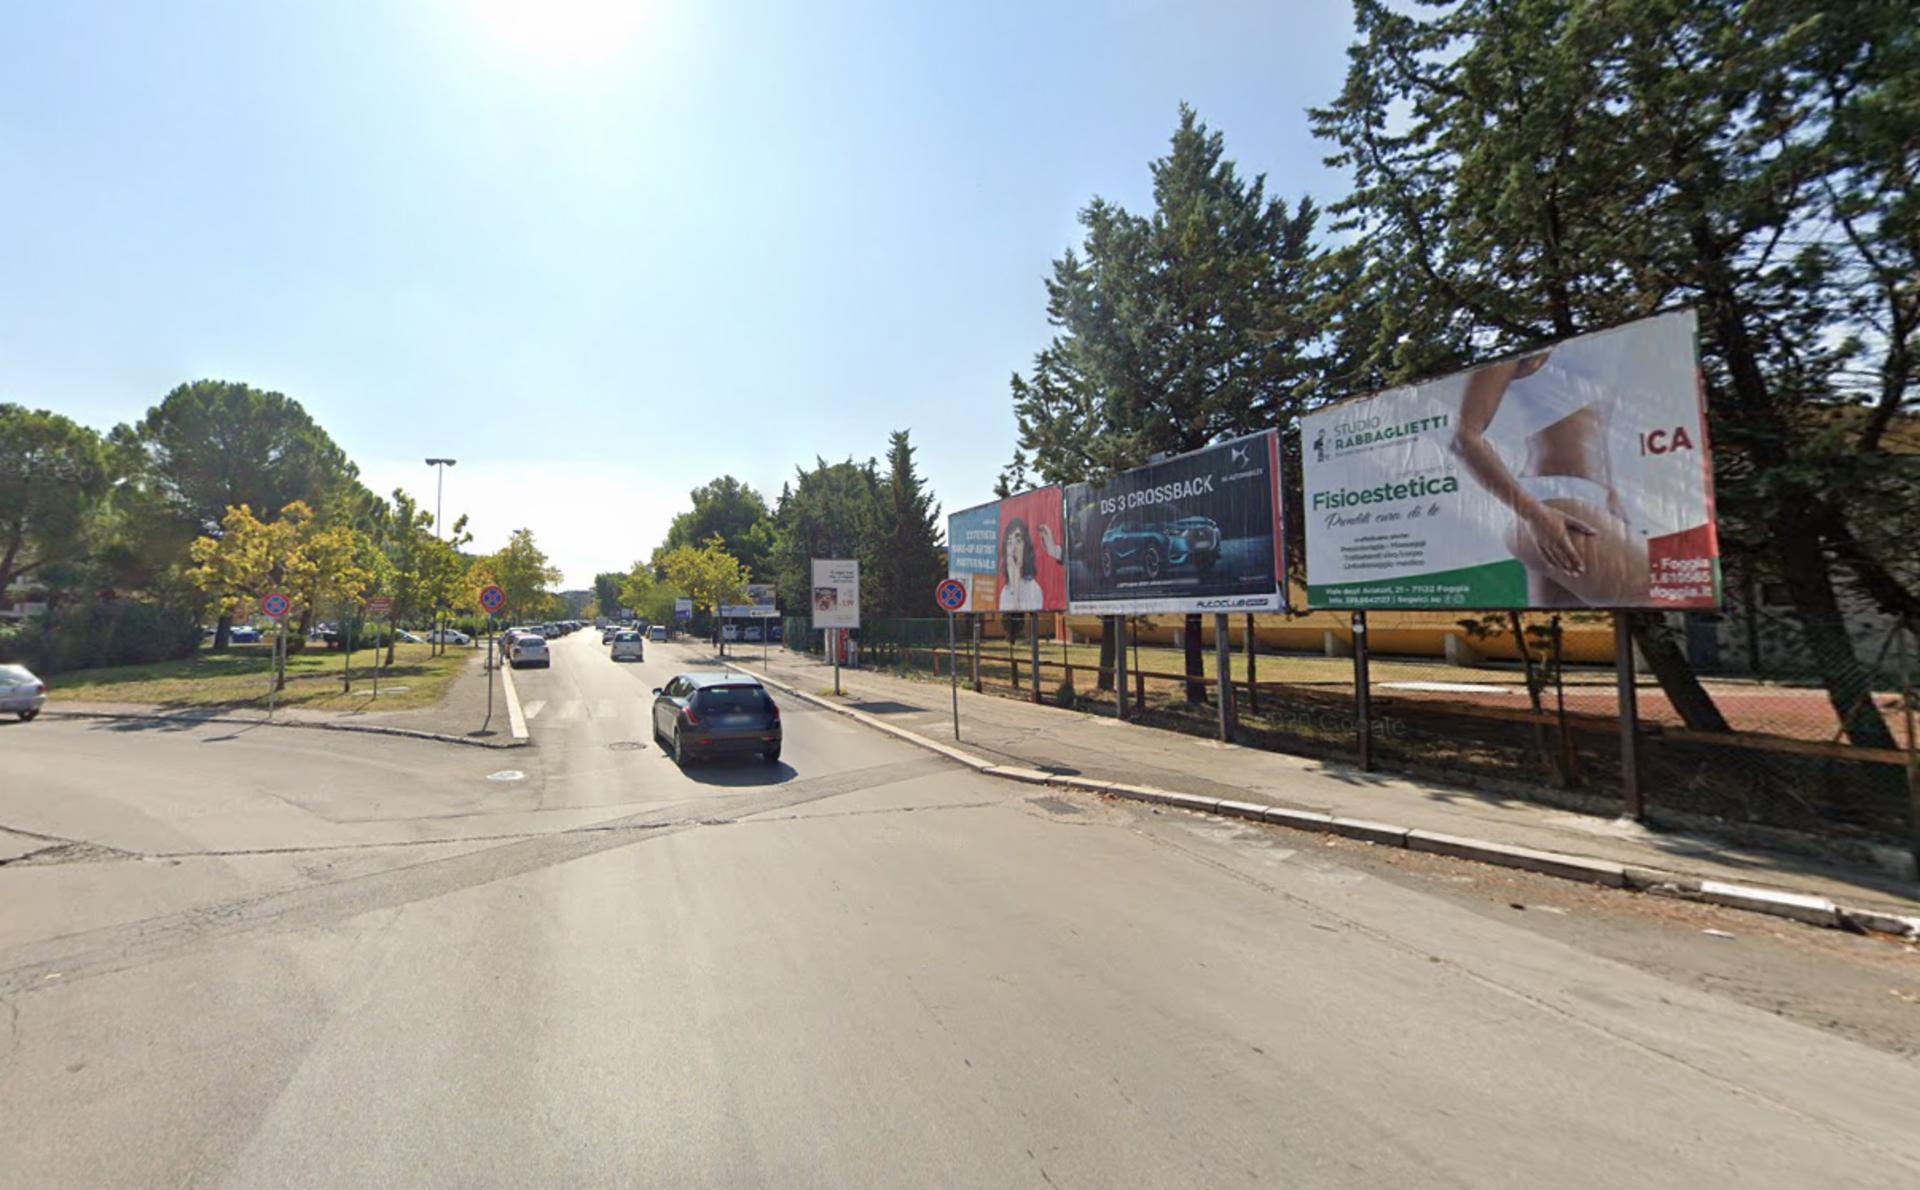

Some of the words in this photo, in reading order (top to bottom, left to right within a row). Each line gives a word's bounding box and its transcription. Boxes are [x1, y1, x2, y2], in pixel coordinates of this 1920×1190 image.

[1334, 416, 1380, 438] STUDIO
[1335, 414, 1449, 450] RABBAGLIETTI
[1100, 498, 1116, 515] DS
[1118, 495, 1126, 511] 3
[1128, 474, 1214, 508] CROSSBACK
[1313, 475, 1458, 511] Fisioestetica
